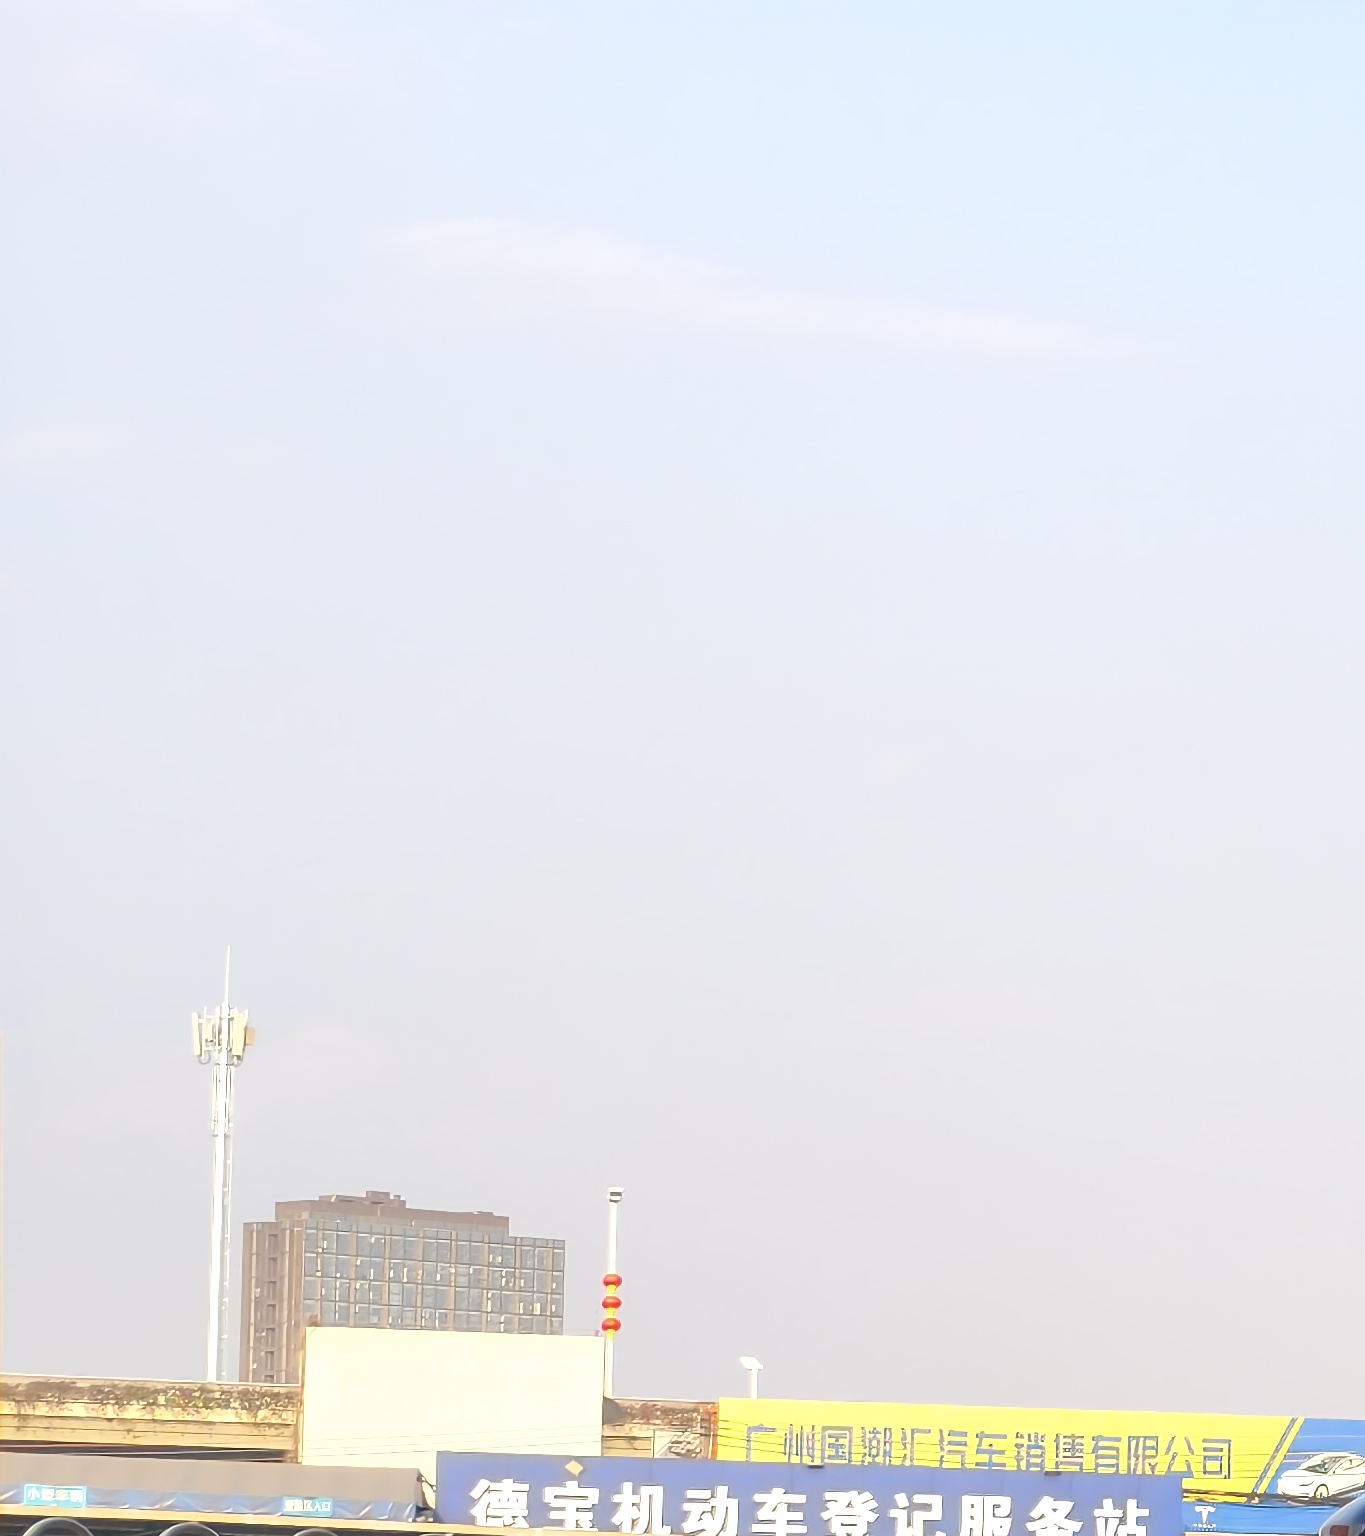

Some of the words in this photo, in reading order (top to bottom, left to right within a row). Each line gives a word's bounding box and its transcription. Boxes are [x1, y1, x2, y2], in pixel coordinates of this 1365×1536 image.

[746, 1424, 1232, 1479] 广州国潮汇汽车销售有限公司
